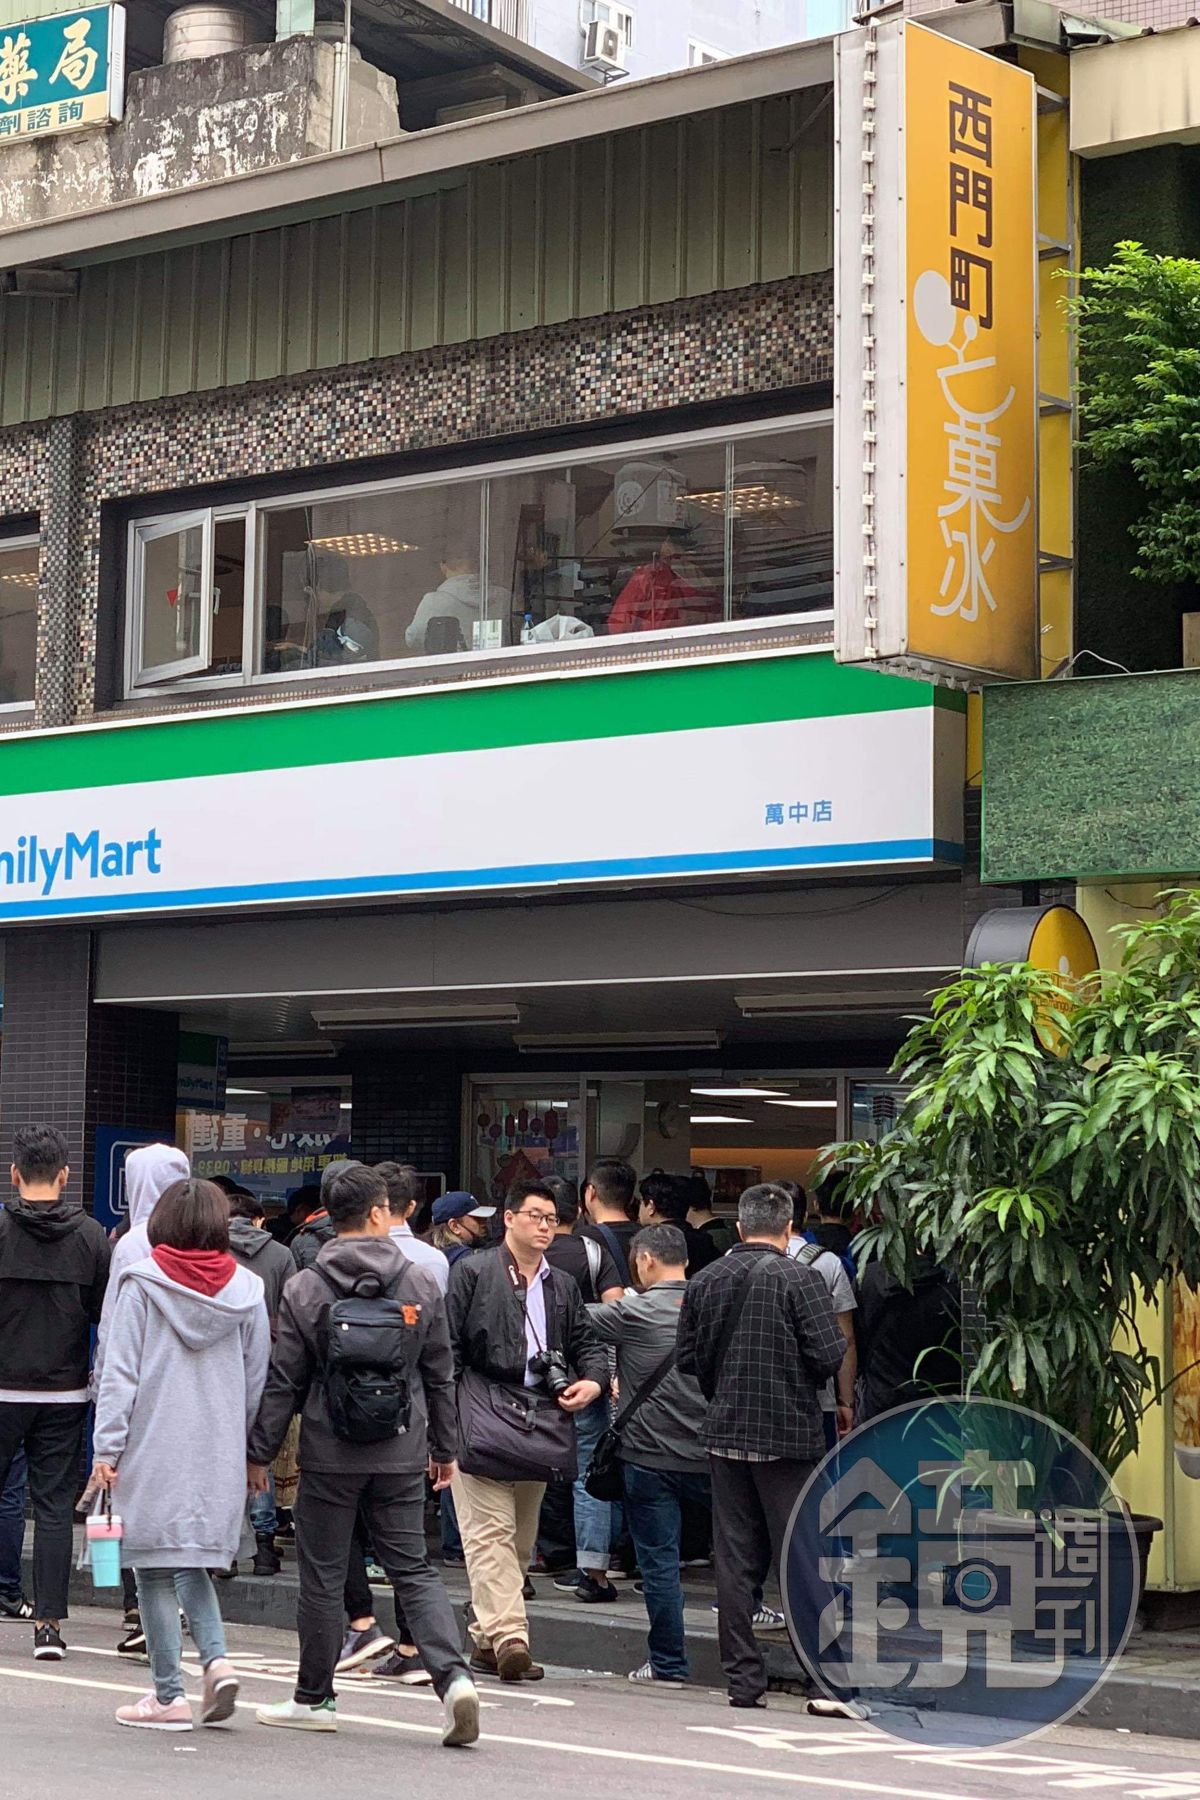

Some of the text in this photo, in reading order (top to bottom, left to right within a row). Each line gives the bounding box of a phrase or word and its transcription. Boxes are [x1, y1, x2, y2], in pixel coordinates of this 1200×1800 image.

[949, 80, 993, 329] 西門町
[765, 800, 832, 825] 萬中店
